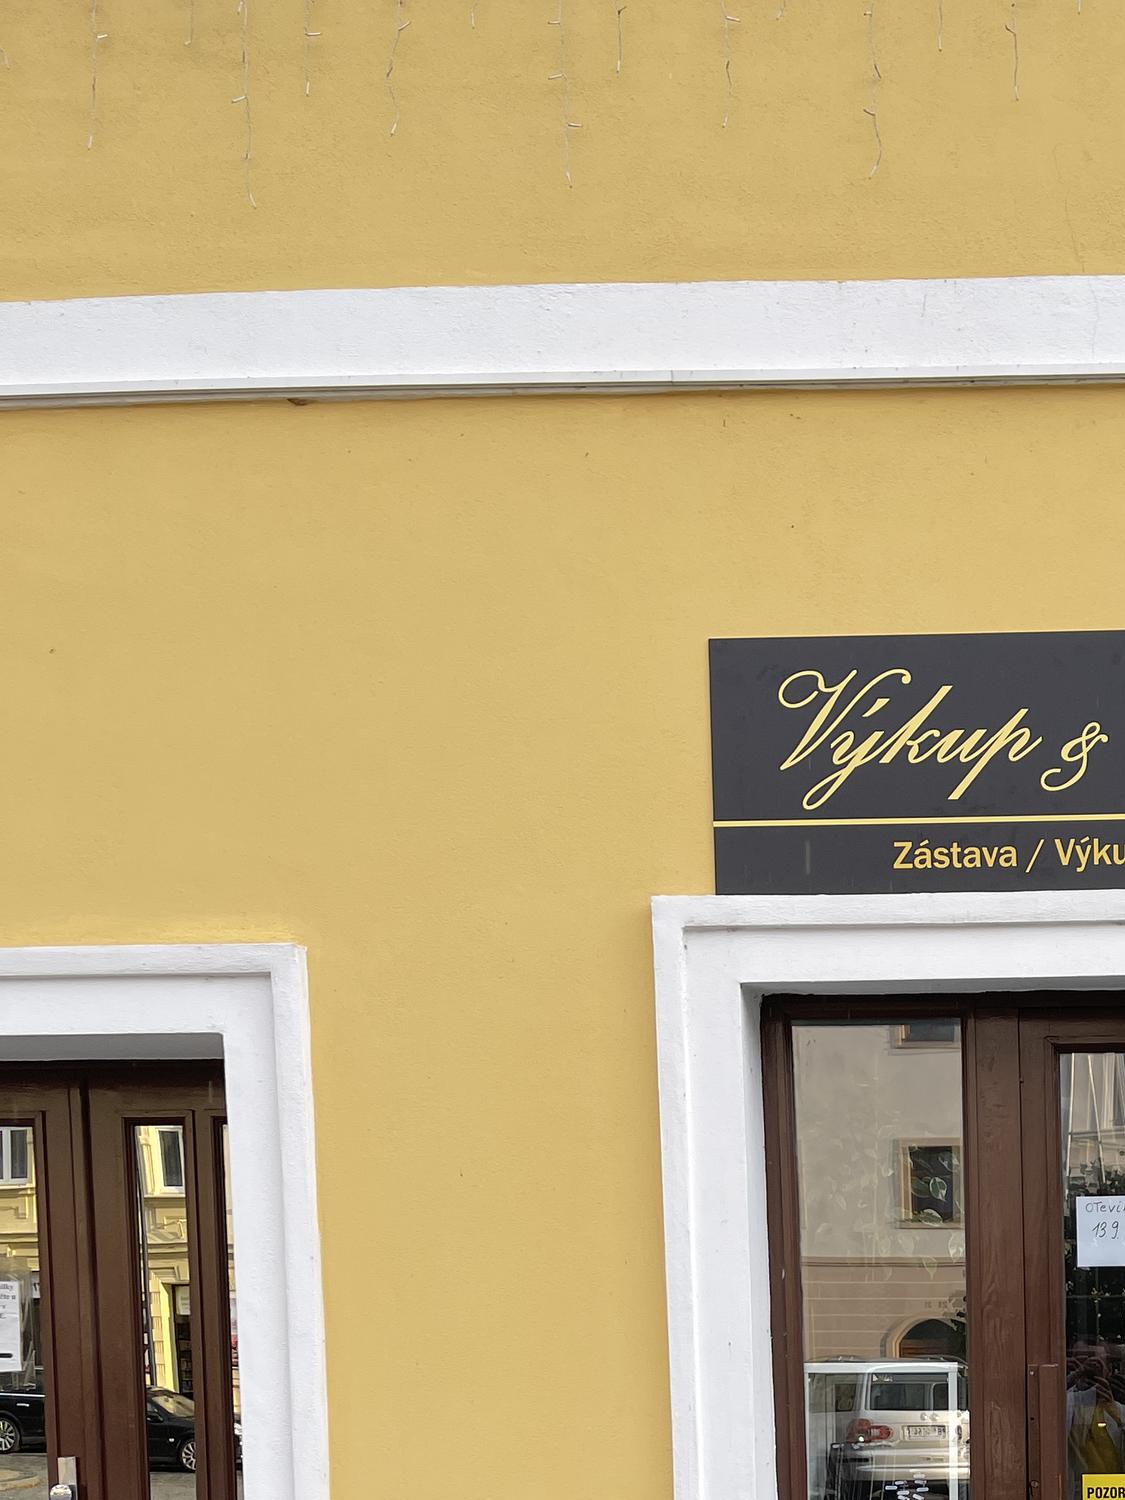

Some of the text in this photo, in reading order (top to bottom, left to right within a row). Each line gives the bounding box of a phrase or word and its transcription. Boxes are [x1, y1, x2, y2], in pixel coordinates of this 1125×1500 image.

[778, 668, 1043, 810] Výkup
[1040, 721, 1109, 792] &
[892, 839, 1018, 870] Zástava
[1025, 838, 1045, 873] /
[1087, 1487, 1125, 1499] POZOR
